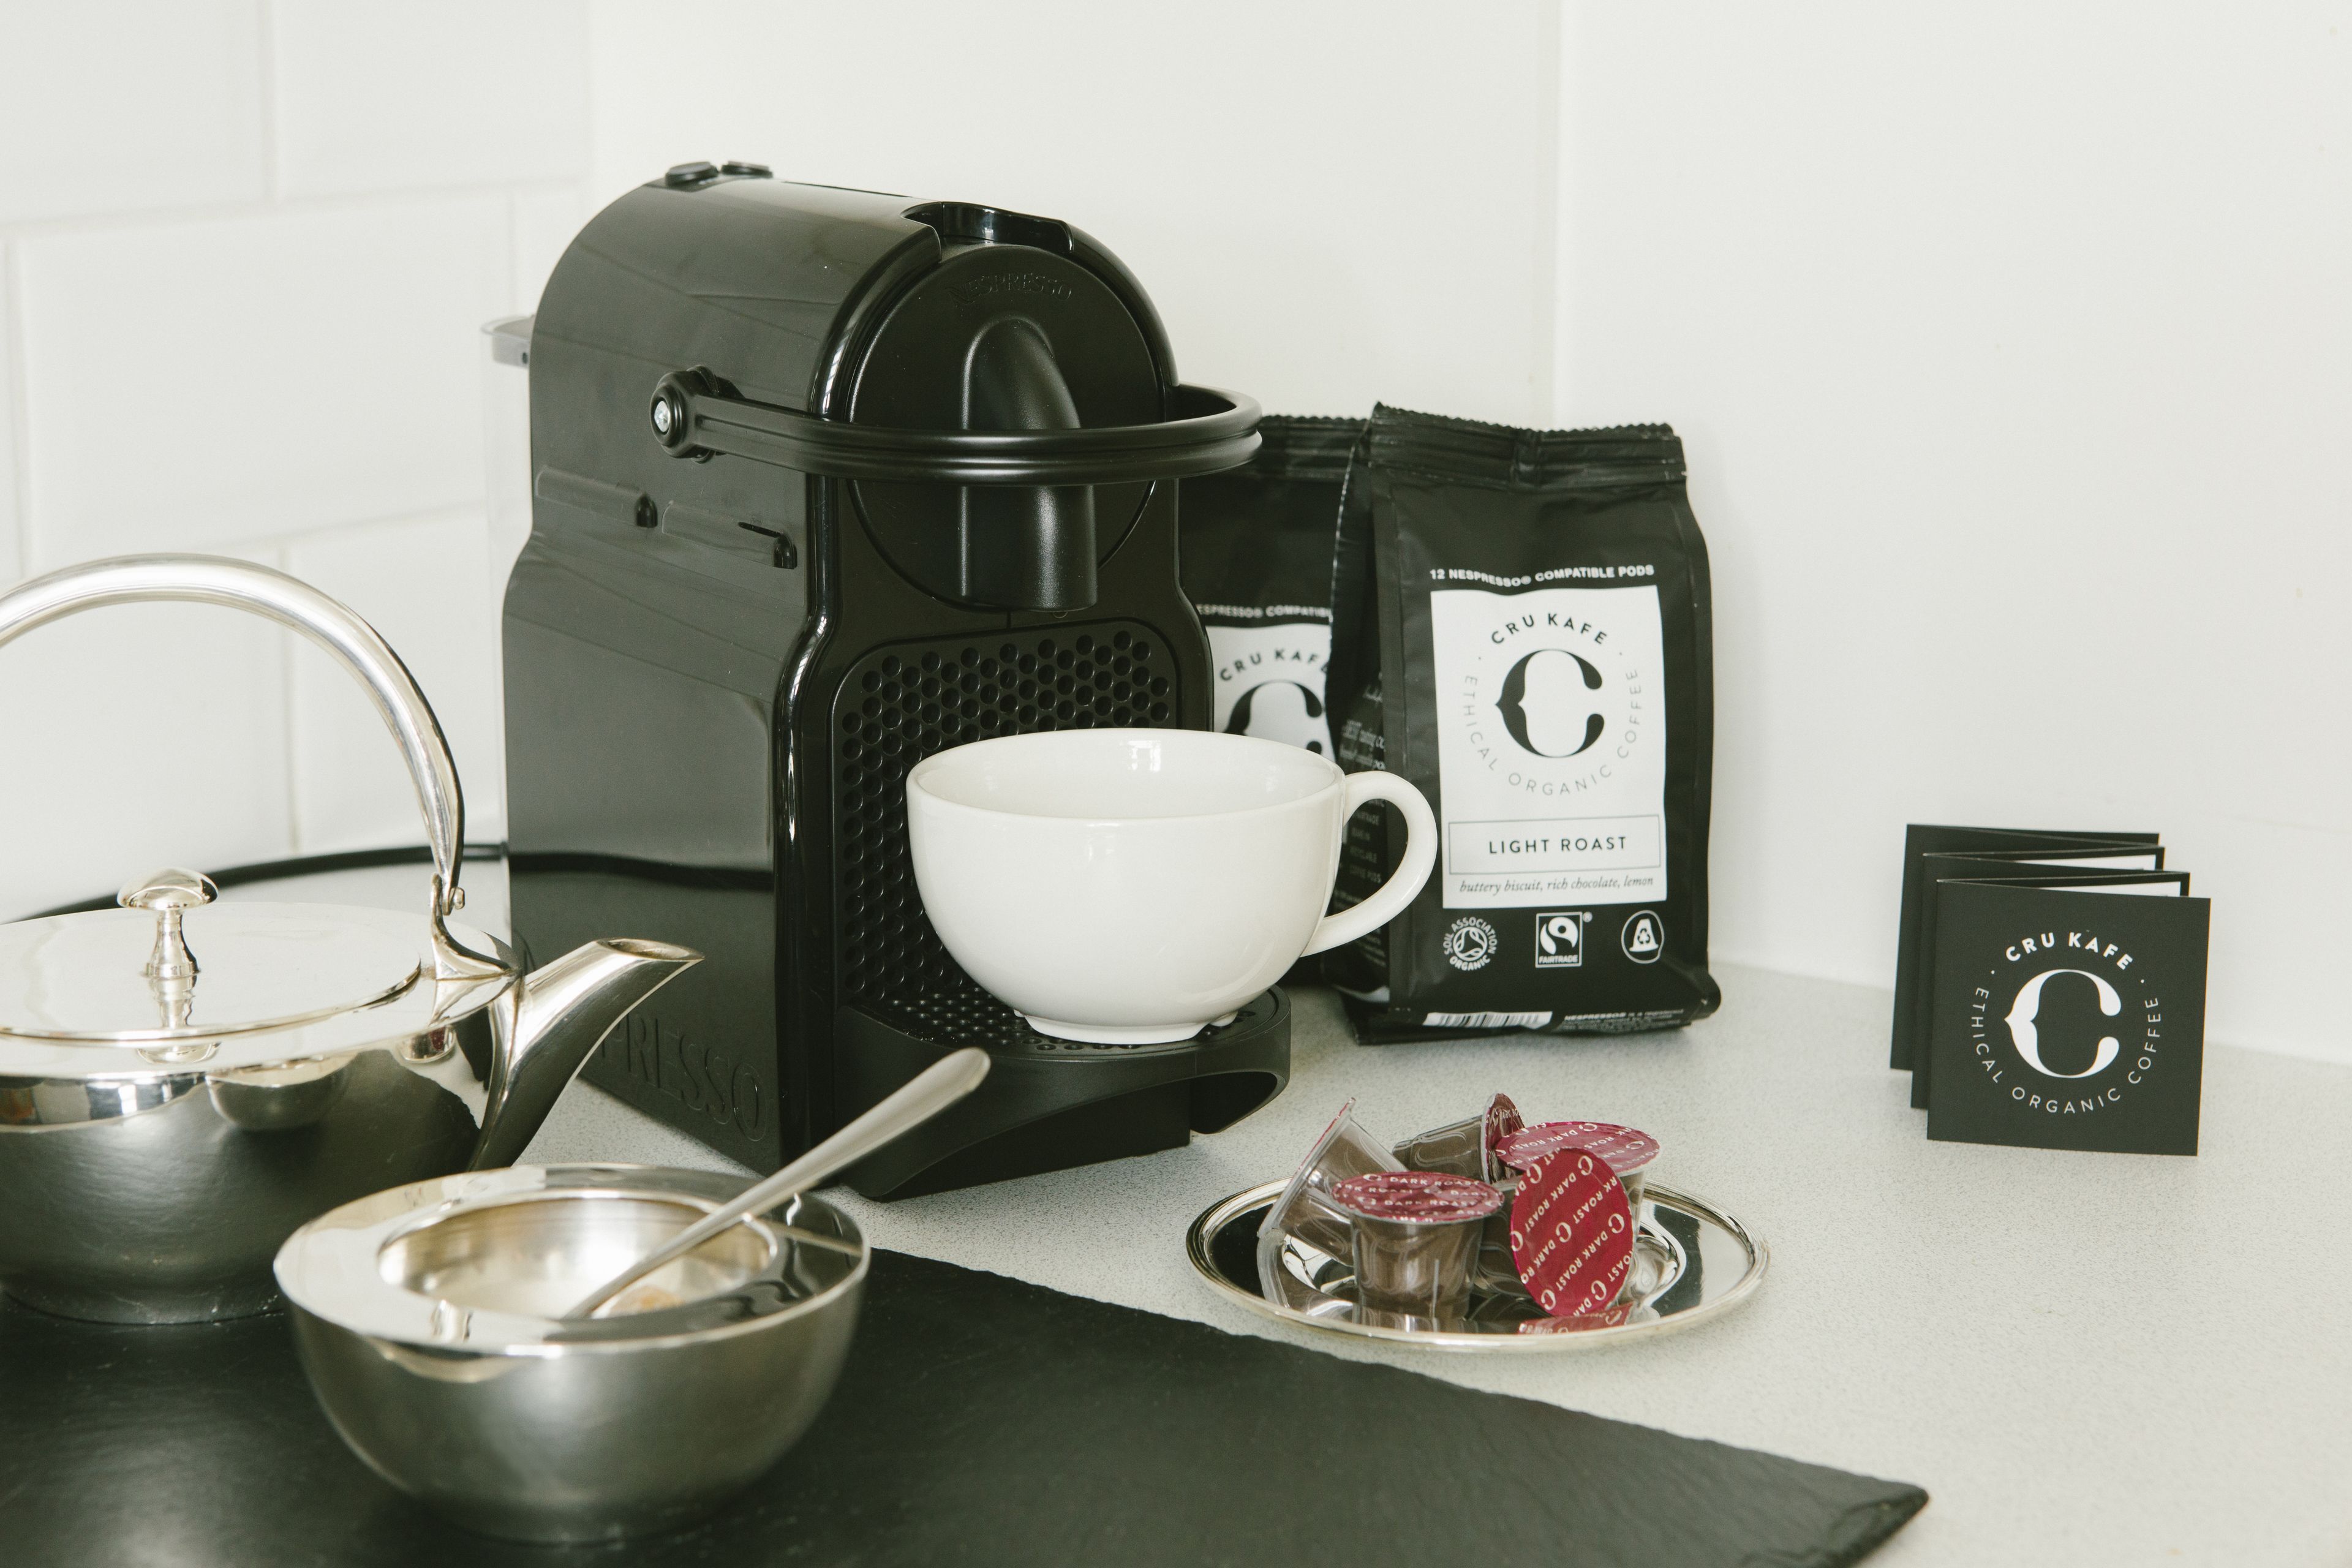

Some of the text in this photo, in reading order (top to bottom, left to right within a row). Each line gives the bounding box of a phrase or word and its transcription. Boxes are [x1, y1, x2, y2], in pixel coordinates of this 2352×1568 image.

[1430, 568, 1446, 580] 12
[1534, 567, 1616, 582] COMPATIBLE
[1618, 564, 1655, 578] PODS
[1490, 612, 1608, 646] CRU KAFE
[1219, 652, 1262, 681] CRU
[1463, 668, 1643, 796] ETHICAL ORGANIC COFFEE
[1488, 836, 1628, 854] LIGHT ROAST
[1460, 875, 1654, 896] buttery biscuit, rich chocolate, lemon
[1442, 916, 1499, 956] SOIL ASSOCIATION
[1449, 954, 1491, 971] ORGANIC
[1539, 954, 1579, 965] FAIRTRADE
[2005, 931, 2134, 971] CRU KAFE
[1970, 986, 2162, 1114] ETHICAL ORGANIC COFFEE
[1509, 1140, 1546, 1151] ROAST
[1547, 1129, 1578, 1142] DARK
[1584, 1136, 1615, 1150] ROAS
[1336, 1182, 1363, 1192] ARK
[1390, 1176, 1428, 1185] DARK
[1550, 1172, 1577, 1201] DARK
[1525, 1199, 1550, 1233] ROAST
[1572, 1190, 1604, 1224] ROAST
[1533, 1239, 1556, 1268] DARK
[1582, 1230, 1608, 1259] DARK
[1556, 1257, 1583, 1291] ROAST
[1607, 1253, 1632, 1283] OAST
